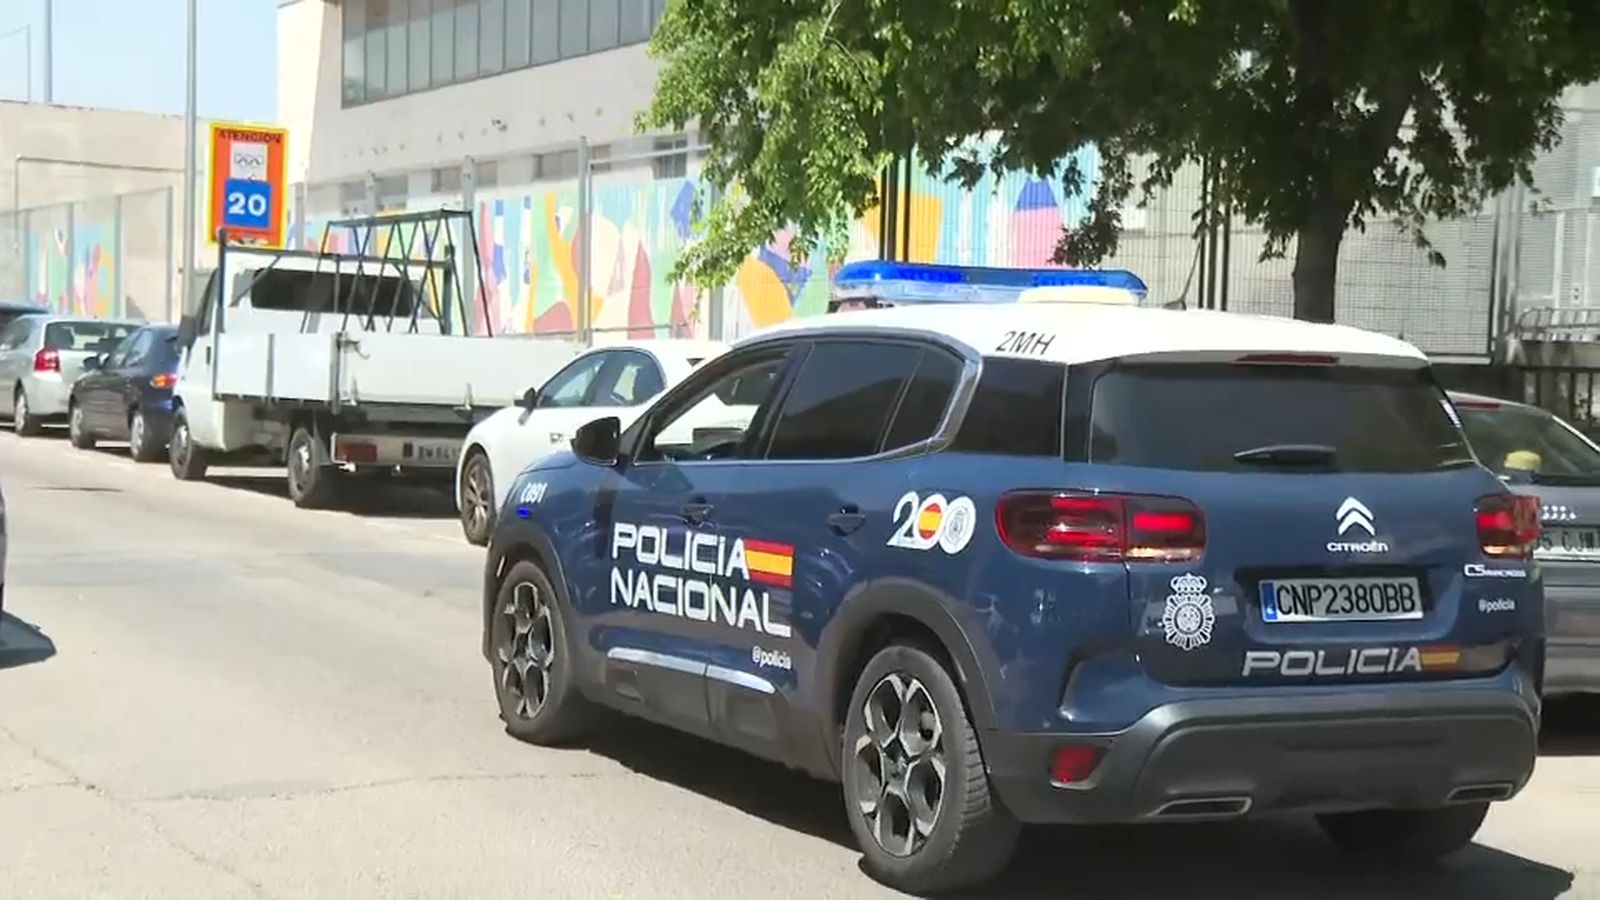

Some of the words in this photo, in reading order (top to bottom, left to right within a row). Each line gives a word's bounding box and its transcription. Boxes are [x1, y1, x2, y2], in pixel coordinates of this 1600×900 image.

[228, 192, 267, 217] 20
[995, 330, 1056, 356] 2MH
[886, 491, 976, 555] 200
[612, 522, 750, 580] POLICIA
[611, 566, 792, 638] NACIONAL
[1277, 583, 1416, 616] CNP2380BB
[752, 645, 792, 670] @policia
[1242, 647, 1422, 677] POLICIA
